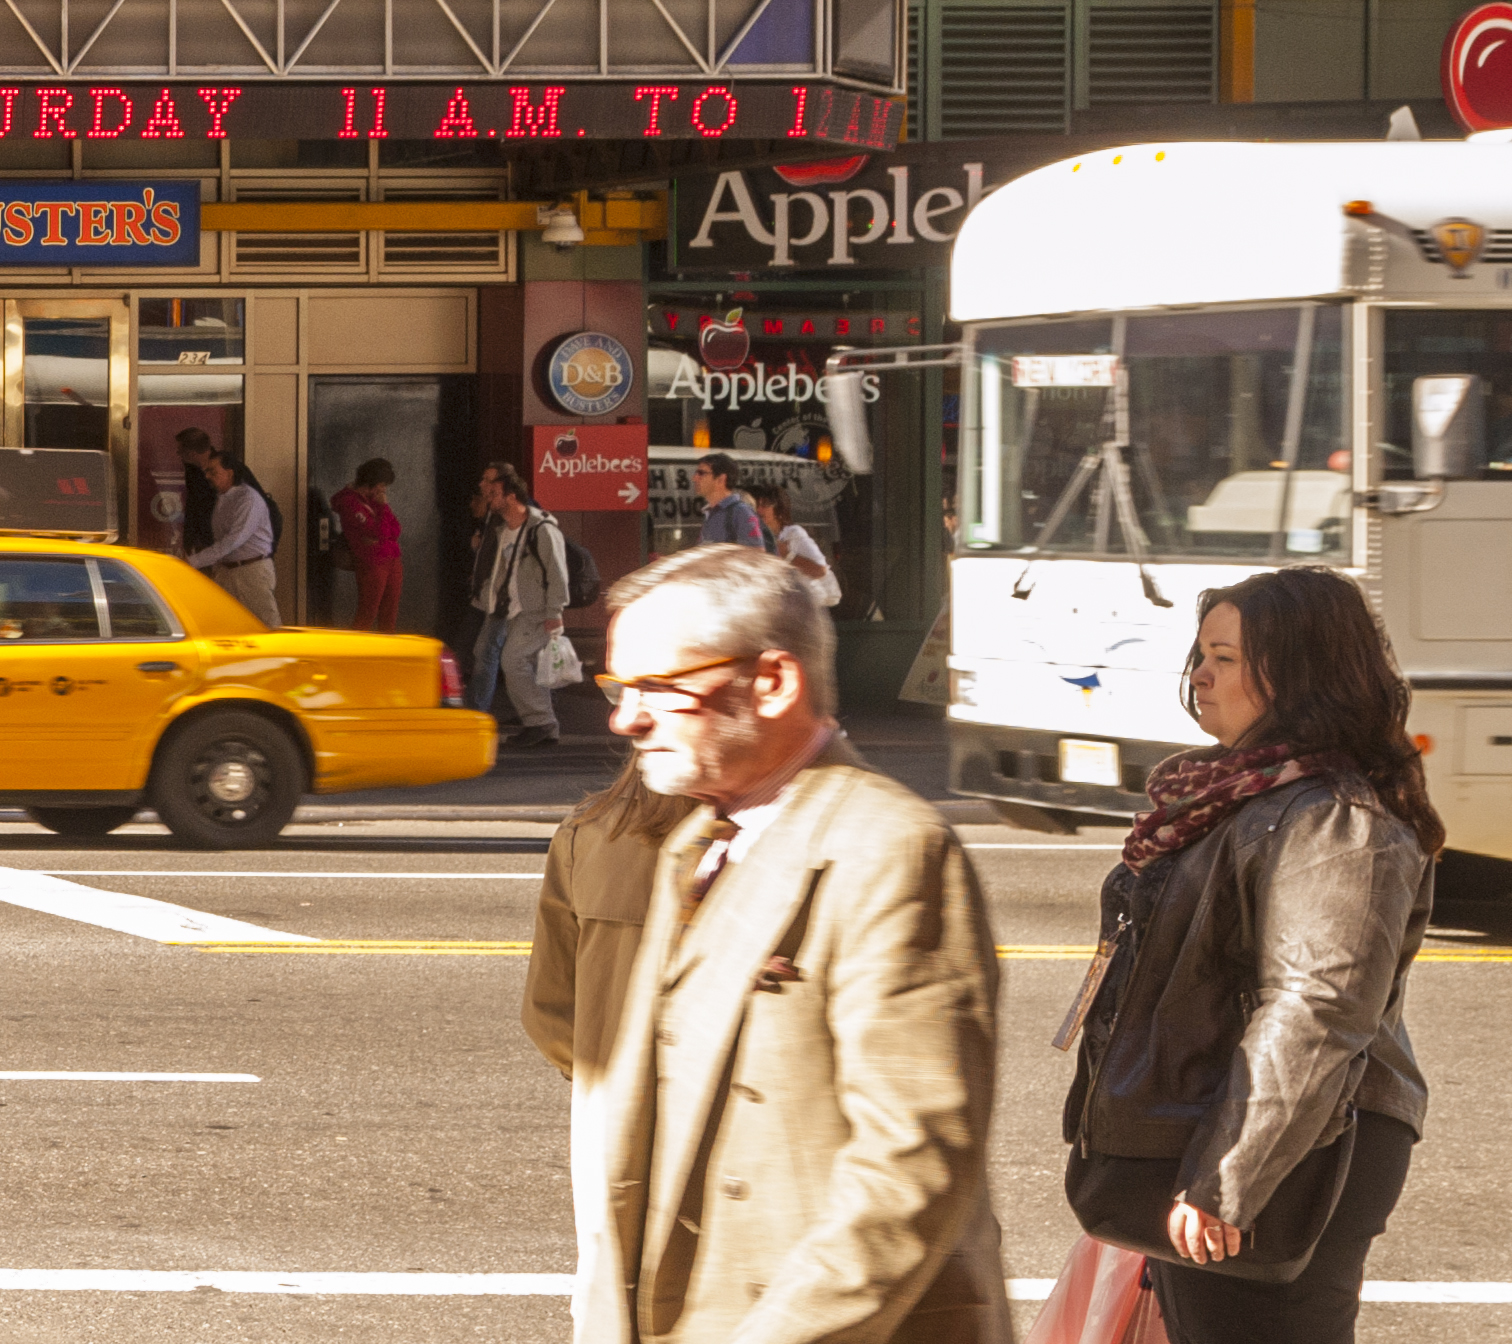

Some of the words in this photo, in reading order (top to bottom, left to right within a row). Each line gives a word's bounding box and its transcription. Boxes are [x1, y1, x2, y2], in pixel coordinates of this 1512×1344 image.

[338, 85, 389, 139] 11
[434, 85, 590, 140] A.M.
[635, 85, 739, 139] TO
[179, 352, 210, 364] 234
[559, 360, 624, 387] D&B
[538, 450, 643, 479] Applebee's
